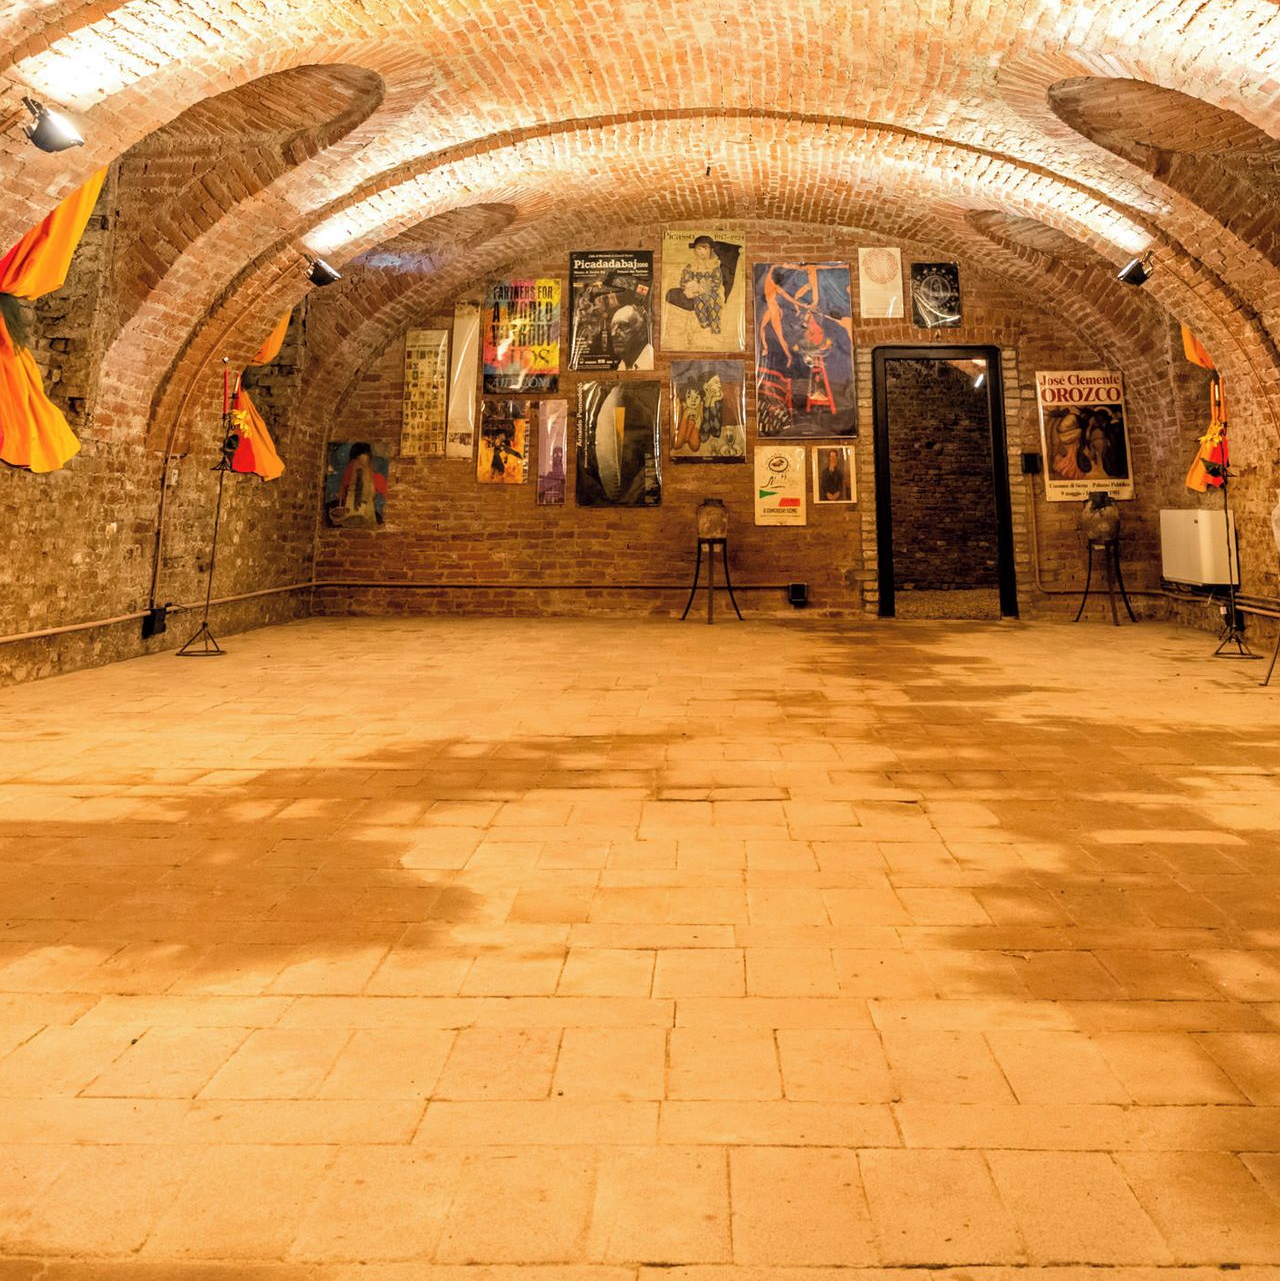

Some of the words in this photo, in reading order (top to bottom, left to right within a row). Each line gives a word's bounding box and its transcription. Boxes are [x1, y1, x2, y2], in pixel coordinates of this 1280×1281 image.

[663, 230, 695, 240] Picasso
[493, 285, 536, 300] PARTNERS
[537, 285, 553, 299] FOR
[492, 301, 500, 323] A
[507, 301, 553, 323] WORLD
[491, 323, 552, 347] WTHOUT
[1040, 374, 1065, 386] José
[1067, 374, 1120, 385] Clemente
[1041, 386, 1121, 402] OROZCO
